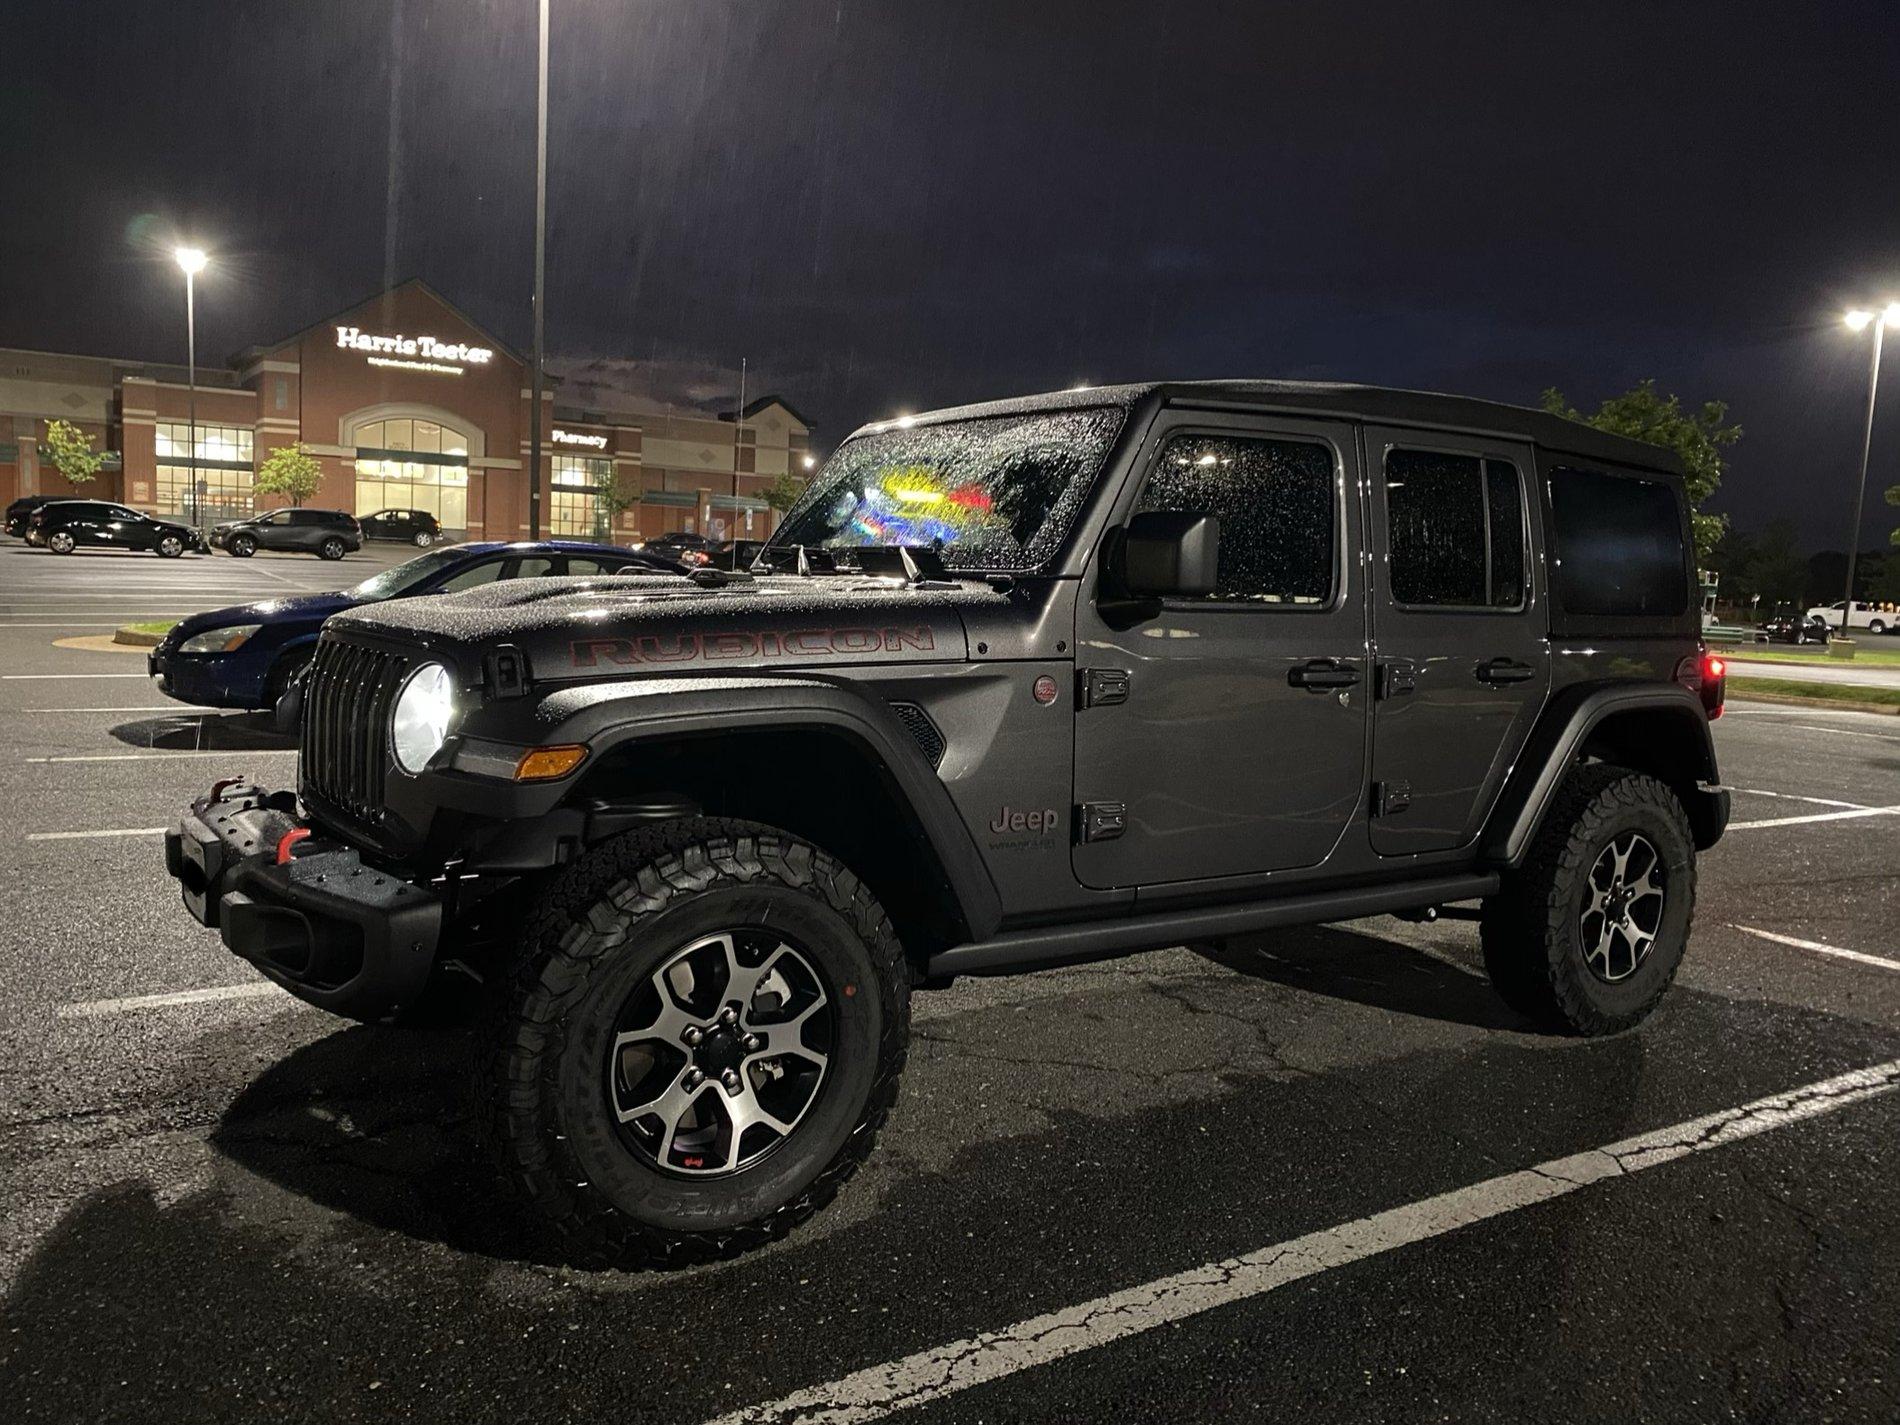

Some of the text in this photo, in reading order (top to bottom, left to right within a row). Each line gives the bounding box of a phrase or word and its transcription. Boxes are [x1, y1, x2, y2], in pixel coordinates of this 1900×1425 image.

[336, 326, 492, 363] Harris Teeter
[552, 430, 608, 449] Pharmacy
[569, 626, 935, 667] RUBICON
[989, 806, 1059, 836] Jeep
